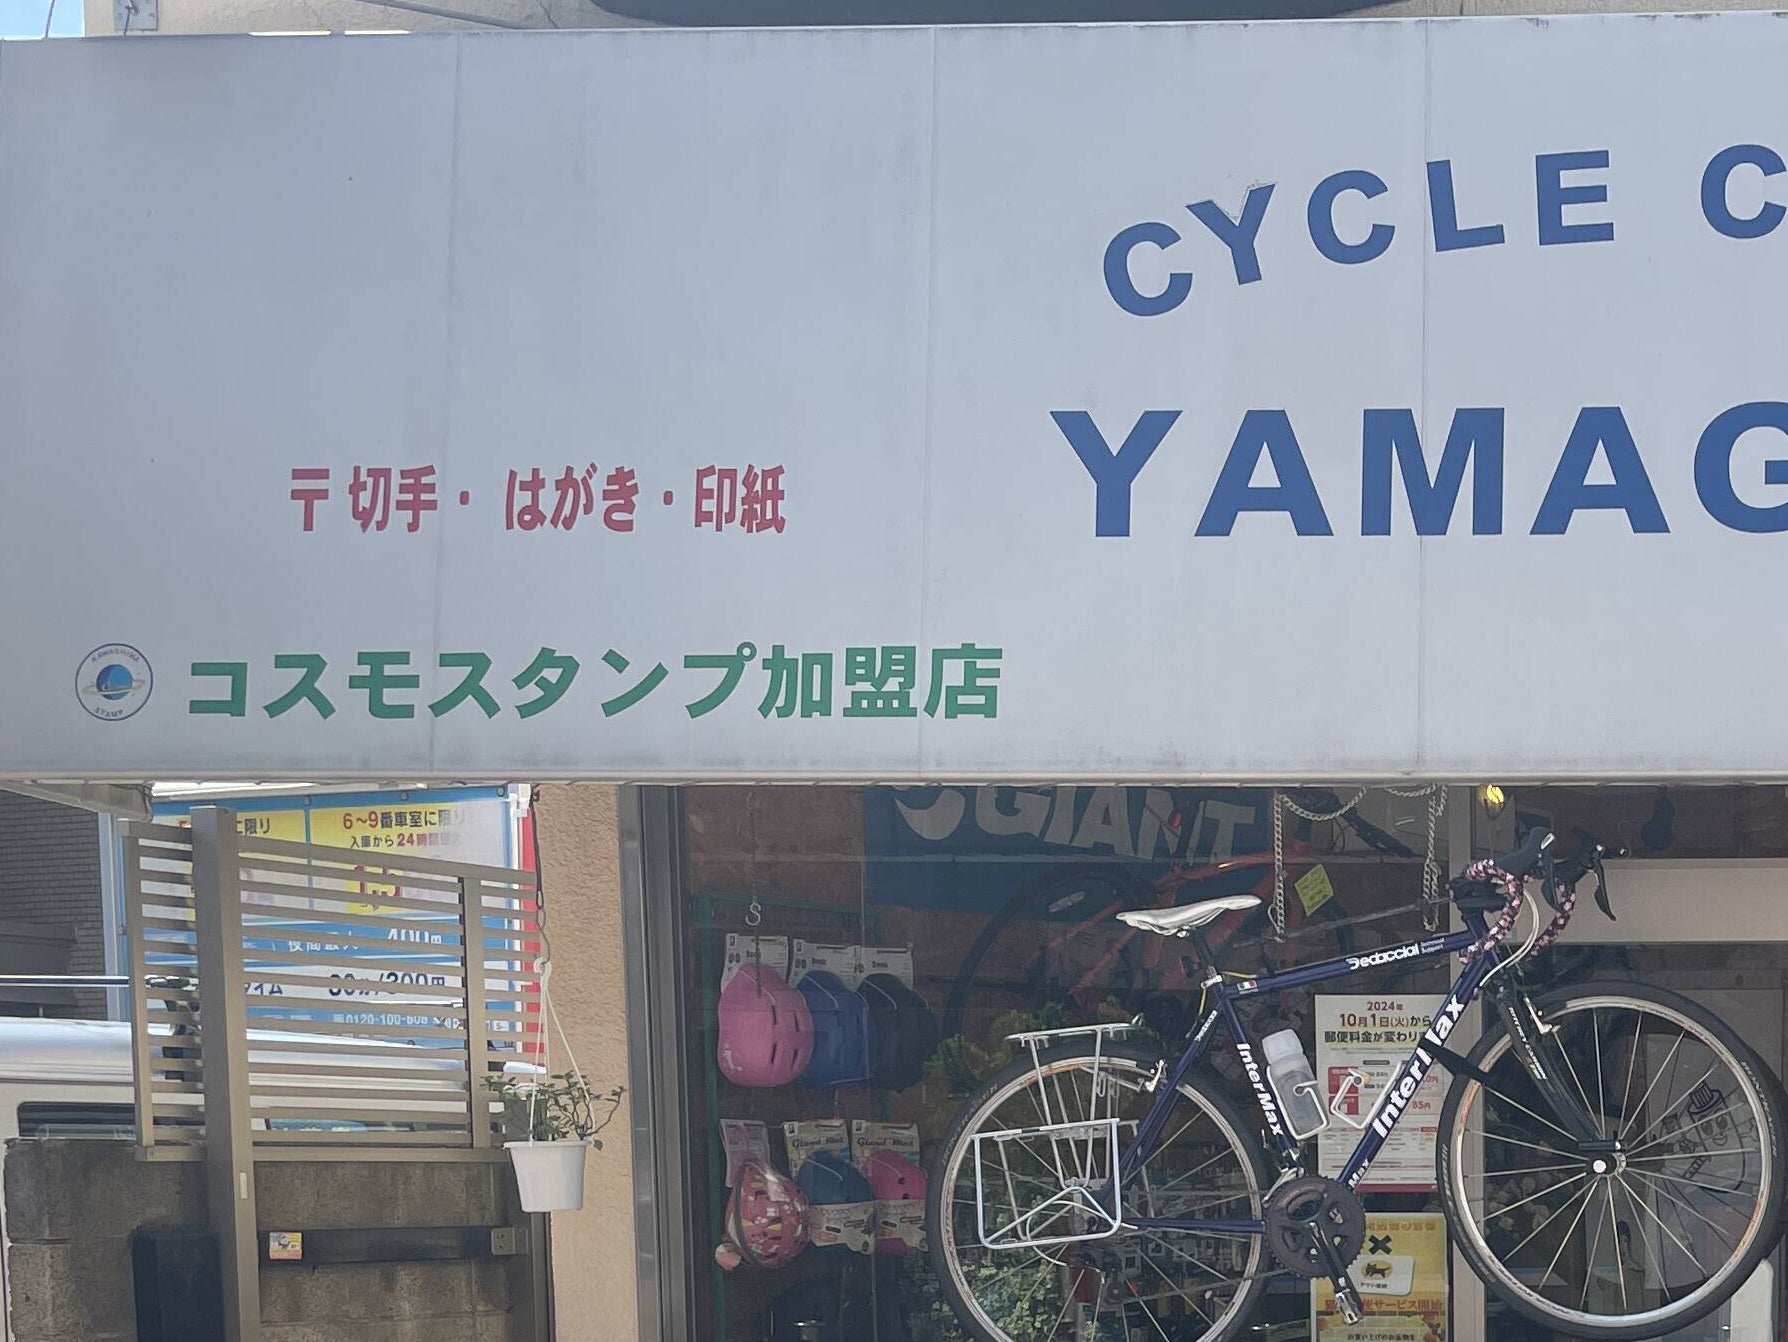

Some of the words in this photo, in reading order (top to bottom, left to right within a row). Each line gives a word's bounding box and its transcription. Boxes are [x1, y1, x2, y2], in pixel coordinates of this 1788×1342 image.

[1102, 149, 1616, 318] CYCLE
[187, 642, 1004, 719] コスモスタンプ加盟店
[1236, 1043, 1284, 1137] InterMax
